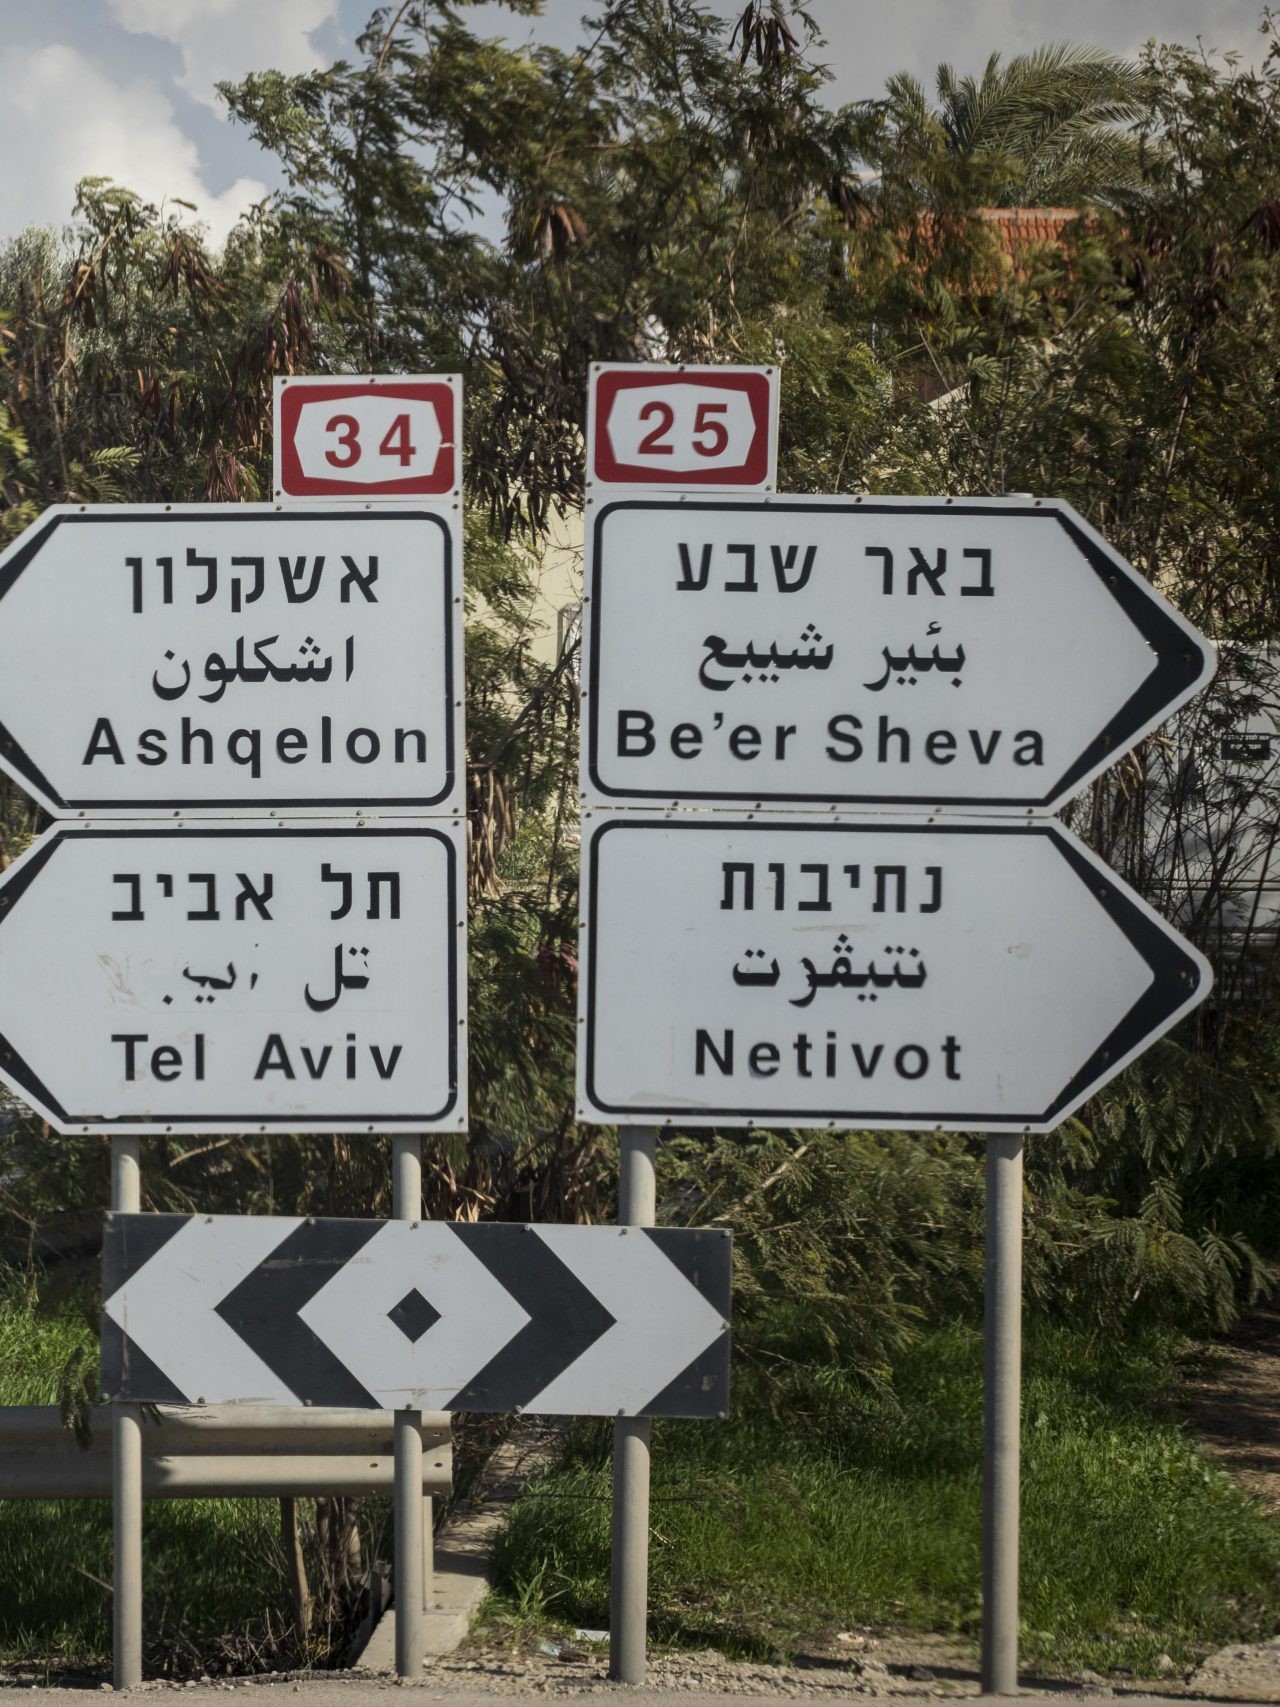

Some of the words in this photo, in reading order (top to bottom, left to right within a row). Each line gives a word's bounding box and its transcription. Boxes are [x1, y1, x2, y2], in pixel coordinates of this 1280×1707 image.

[325, 414, 416, 468] 34
[637, 400, 729, 457] 25
[125, 547, 379, 614] אשקלון
[676, 542, 818, 594] שבע
[864, 546, 995, 597] באר
[152, 634, 354, 704] اشكلون
[698, 623, 834, 692] شيبع
[82, 715, 427, 779] Ashqelon
[616, 709, 797, 762] Be'er
[825, 713, 1045, 767] Sheva
[111, 872, 274, 922] אביב
[320, 862, 401, 921] תל
[720, 861, 943, 914] נתיבות
[304, 943, 370, 1013] تل
[110, 1033, 205, 1082] Tel
[253, 1033, 403, 1080] Aviv
[695, 1028, 962, 1081] Netivot
